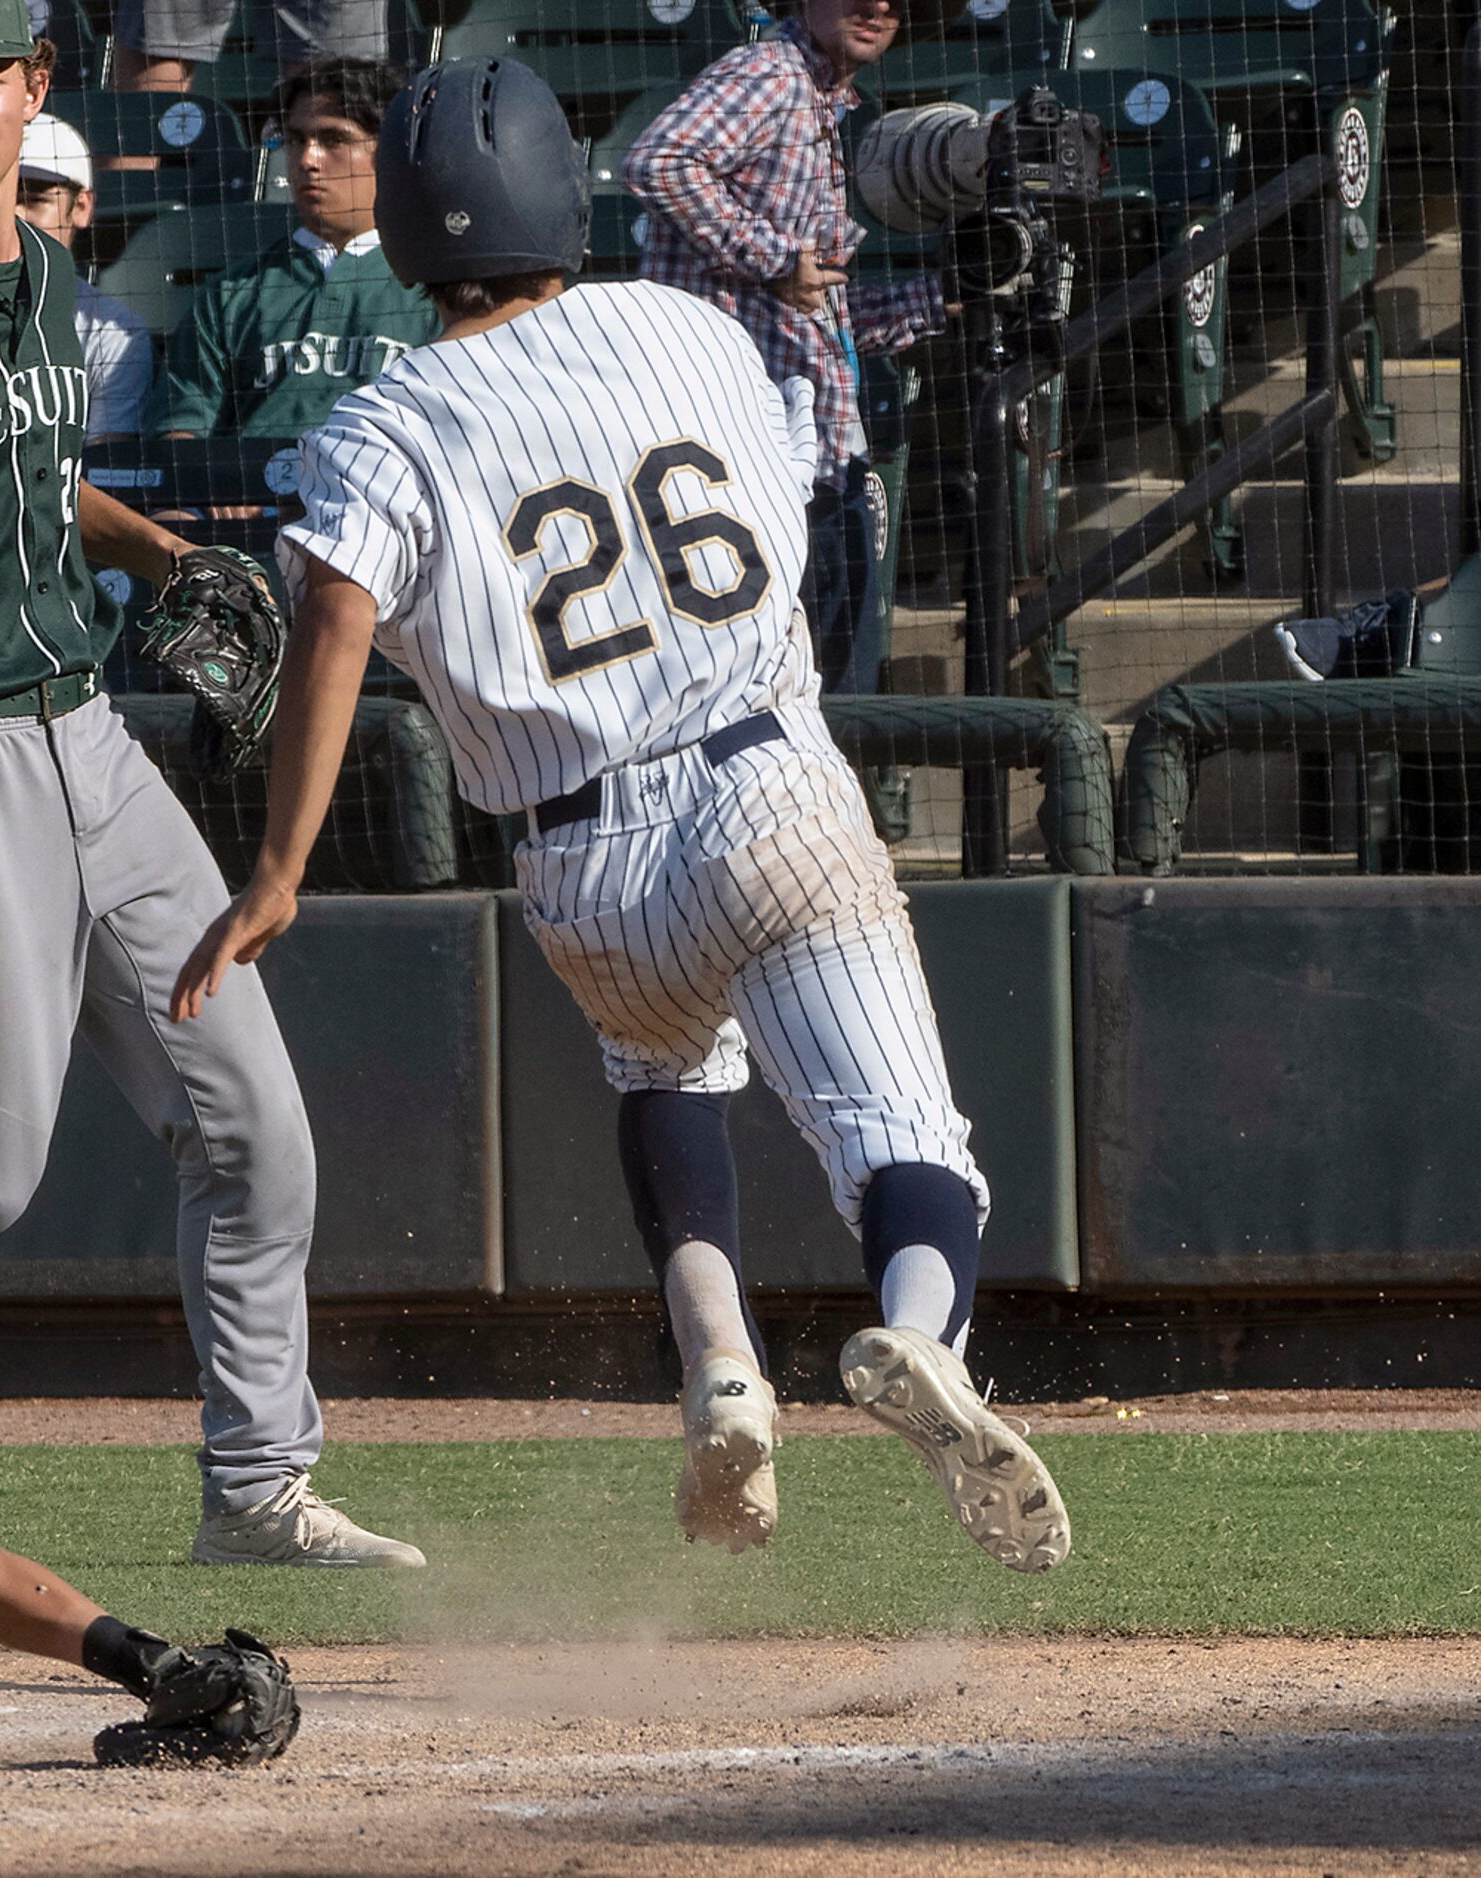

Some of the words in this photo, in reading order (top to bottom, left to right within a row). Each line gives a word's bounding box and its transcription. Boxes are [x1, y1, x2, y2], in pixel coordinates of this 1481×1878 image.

[59, 457, 83, 525] 2
[281, 462, 293, 480] 2
[500, 434, 776, 687] 26
